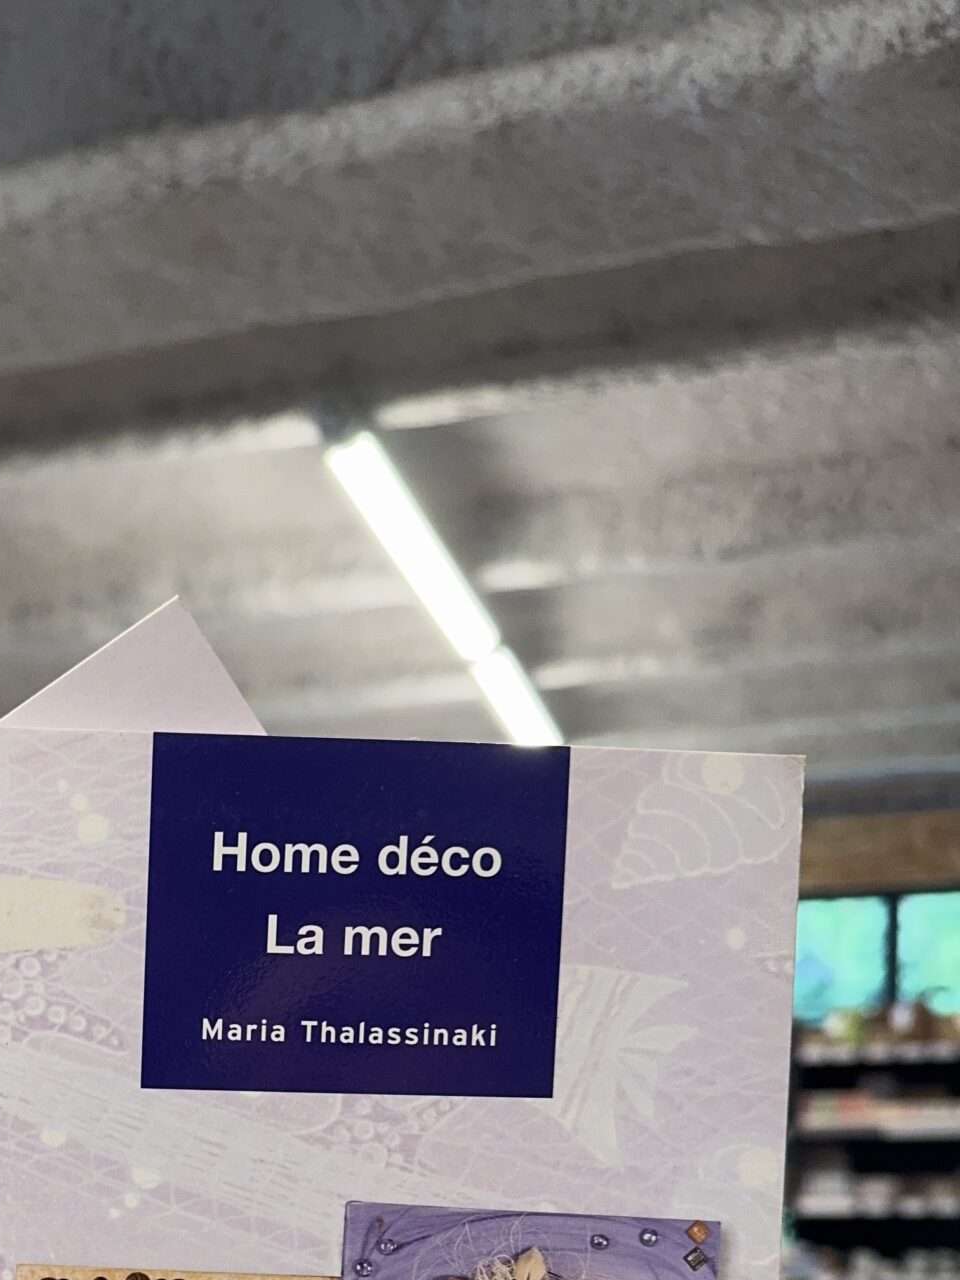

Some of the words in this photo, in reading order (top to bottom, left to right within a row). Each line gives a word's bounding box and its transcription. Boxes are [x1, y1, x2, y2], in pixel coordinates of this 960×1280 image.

[211, 831, 360, 875] Home
[377, 835, 502, 877] déco
[265, 914, 324, 955] La
[343, 924, 443, 957] mer
[201, 1018, 286, 1042] Maria
[301, 1020, 497, 1047] Thalassinaki
